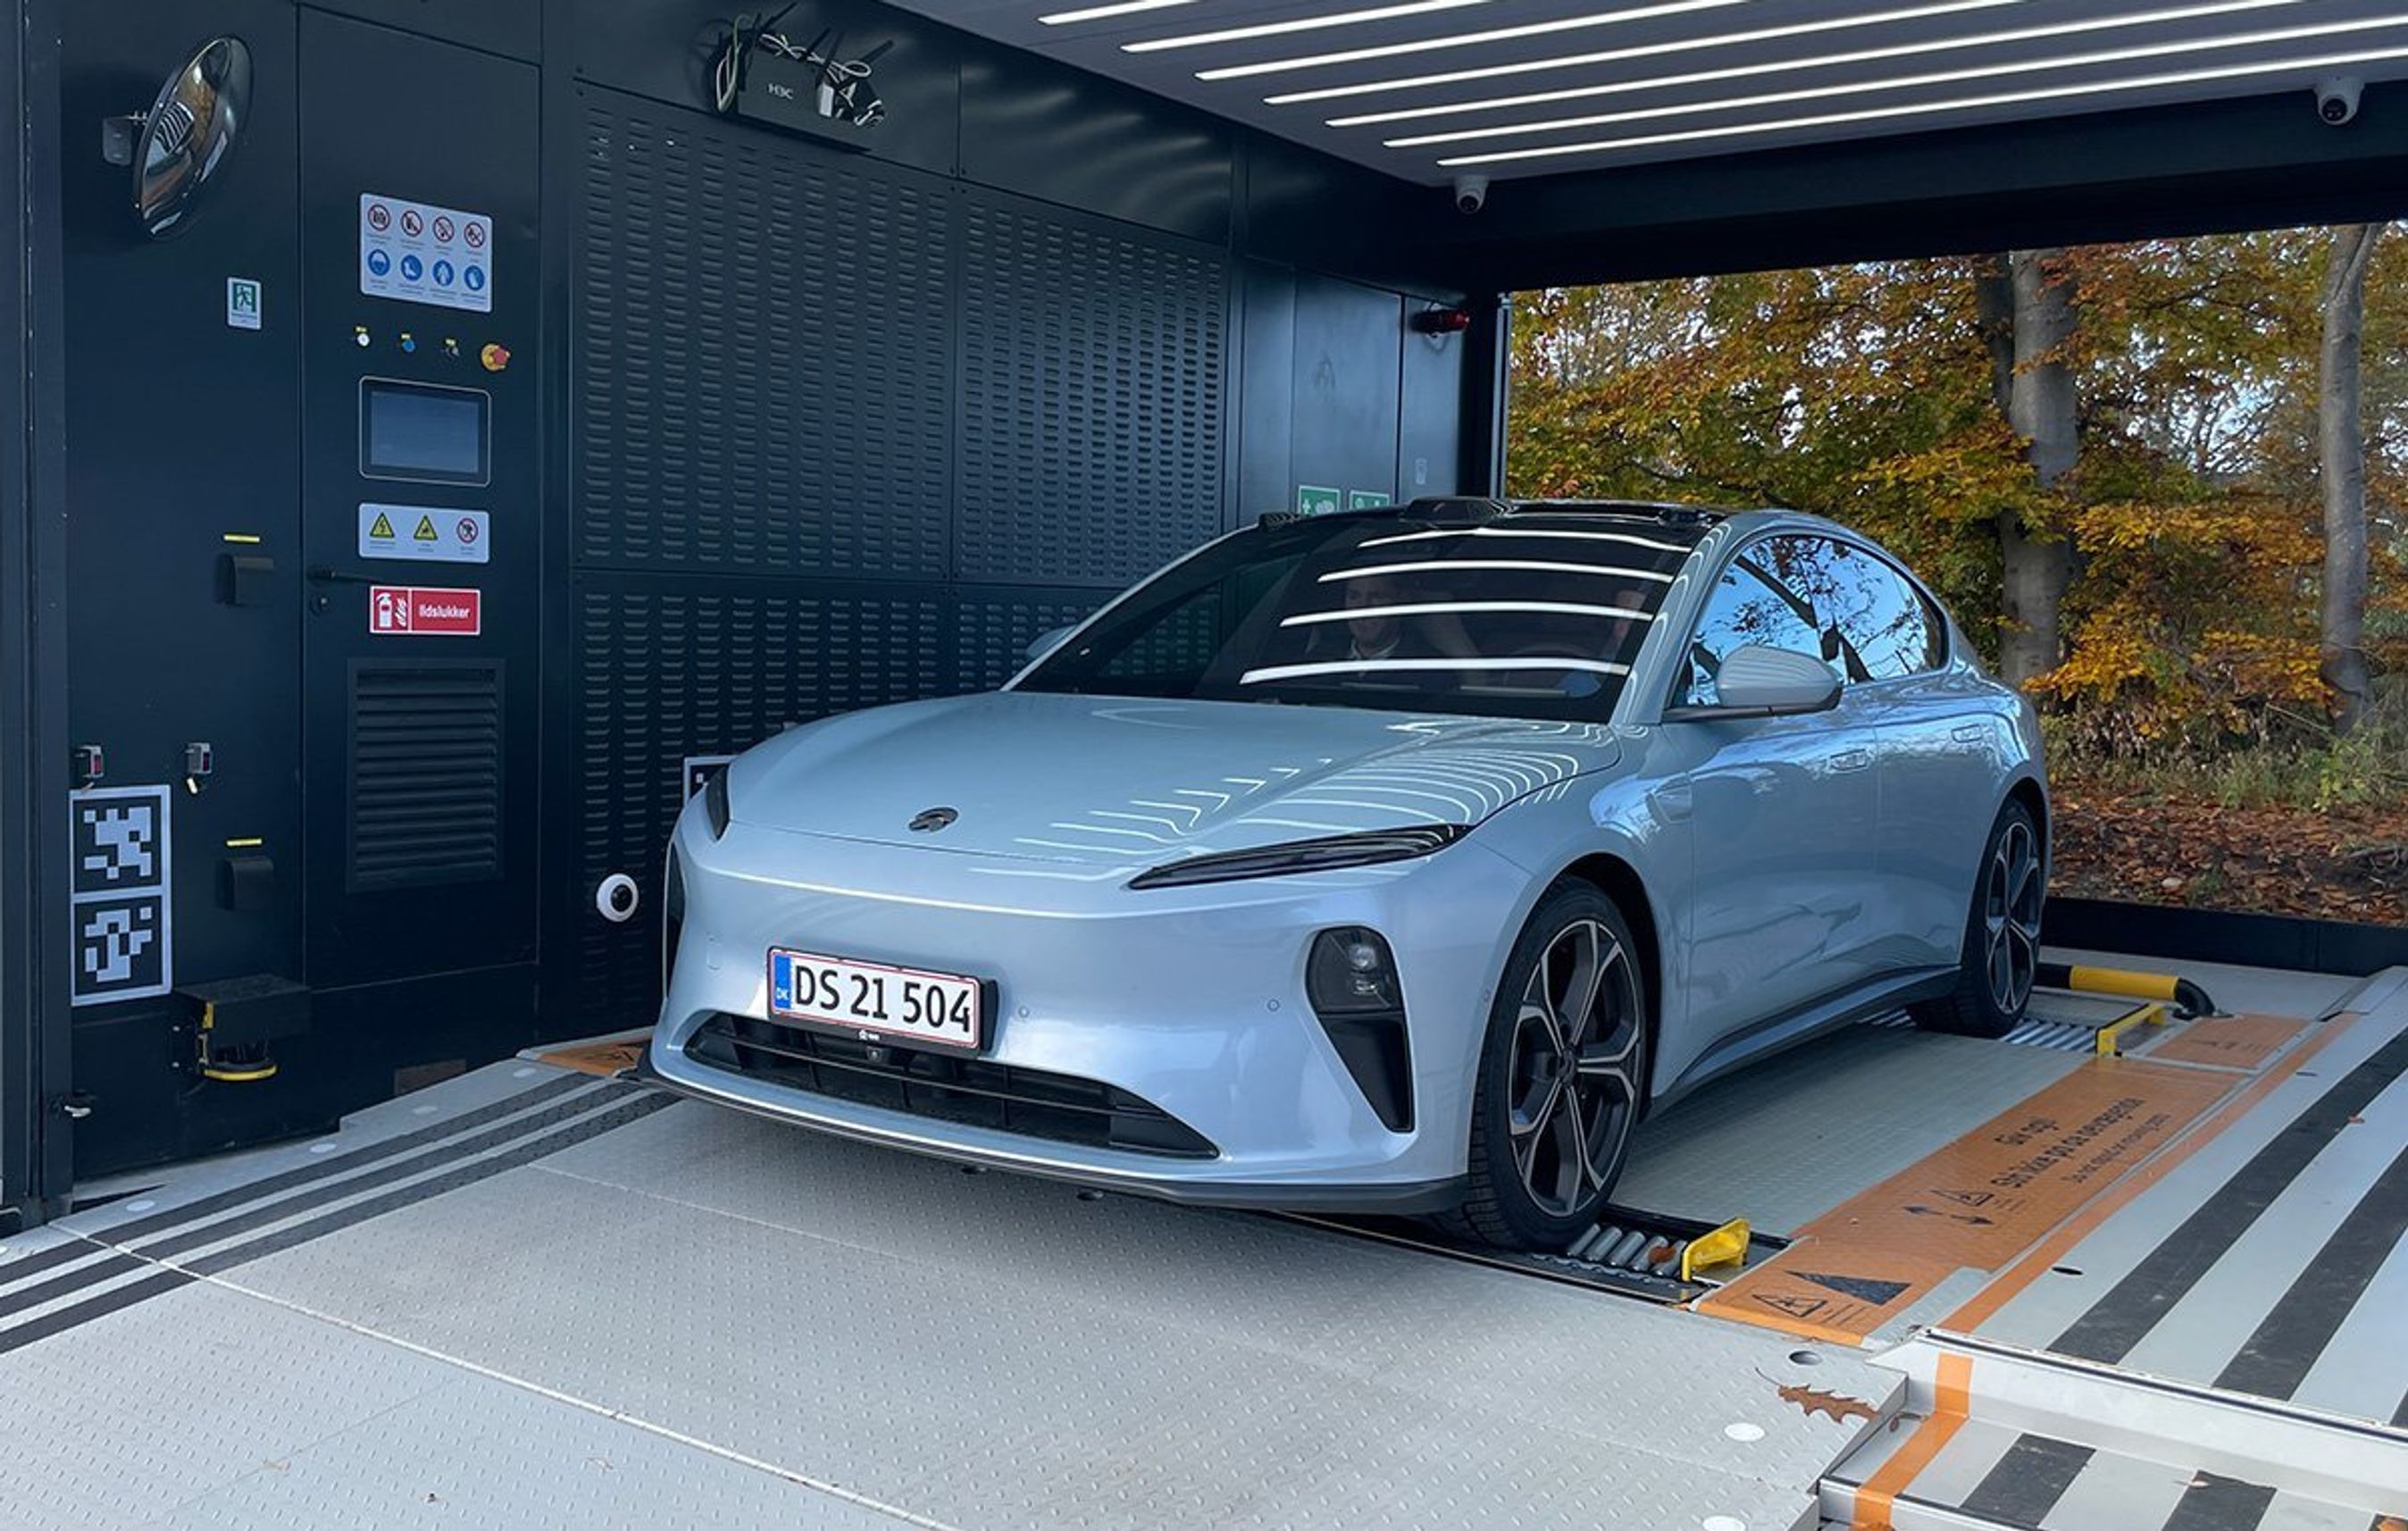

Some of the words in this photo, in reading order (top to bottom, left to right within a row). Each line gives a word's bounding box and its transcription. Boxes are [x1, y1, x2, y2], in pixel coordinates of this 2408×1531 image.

[767, 83, 794, 99] H3C
[776, 988, 790, 1000] DK
[795, 965, 840, 1010] DS
[850, 975, 888, 1020] 21
[903, 982, 970, 1033] 504
